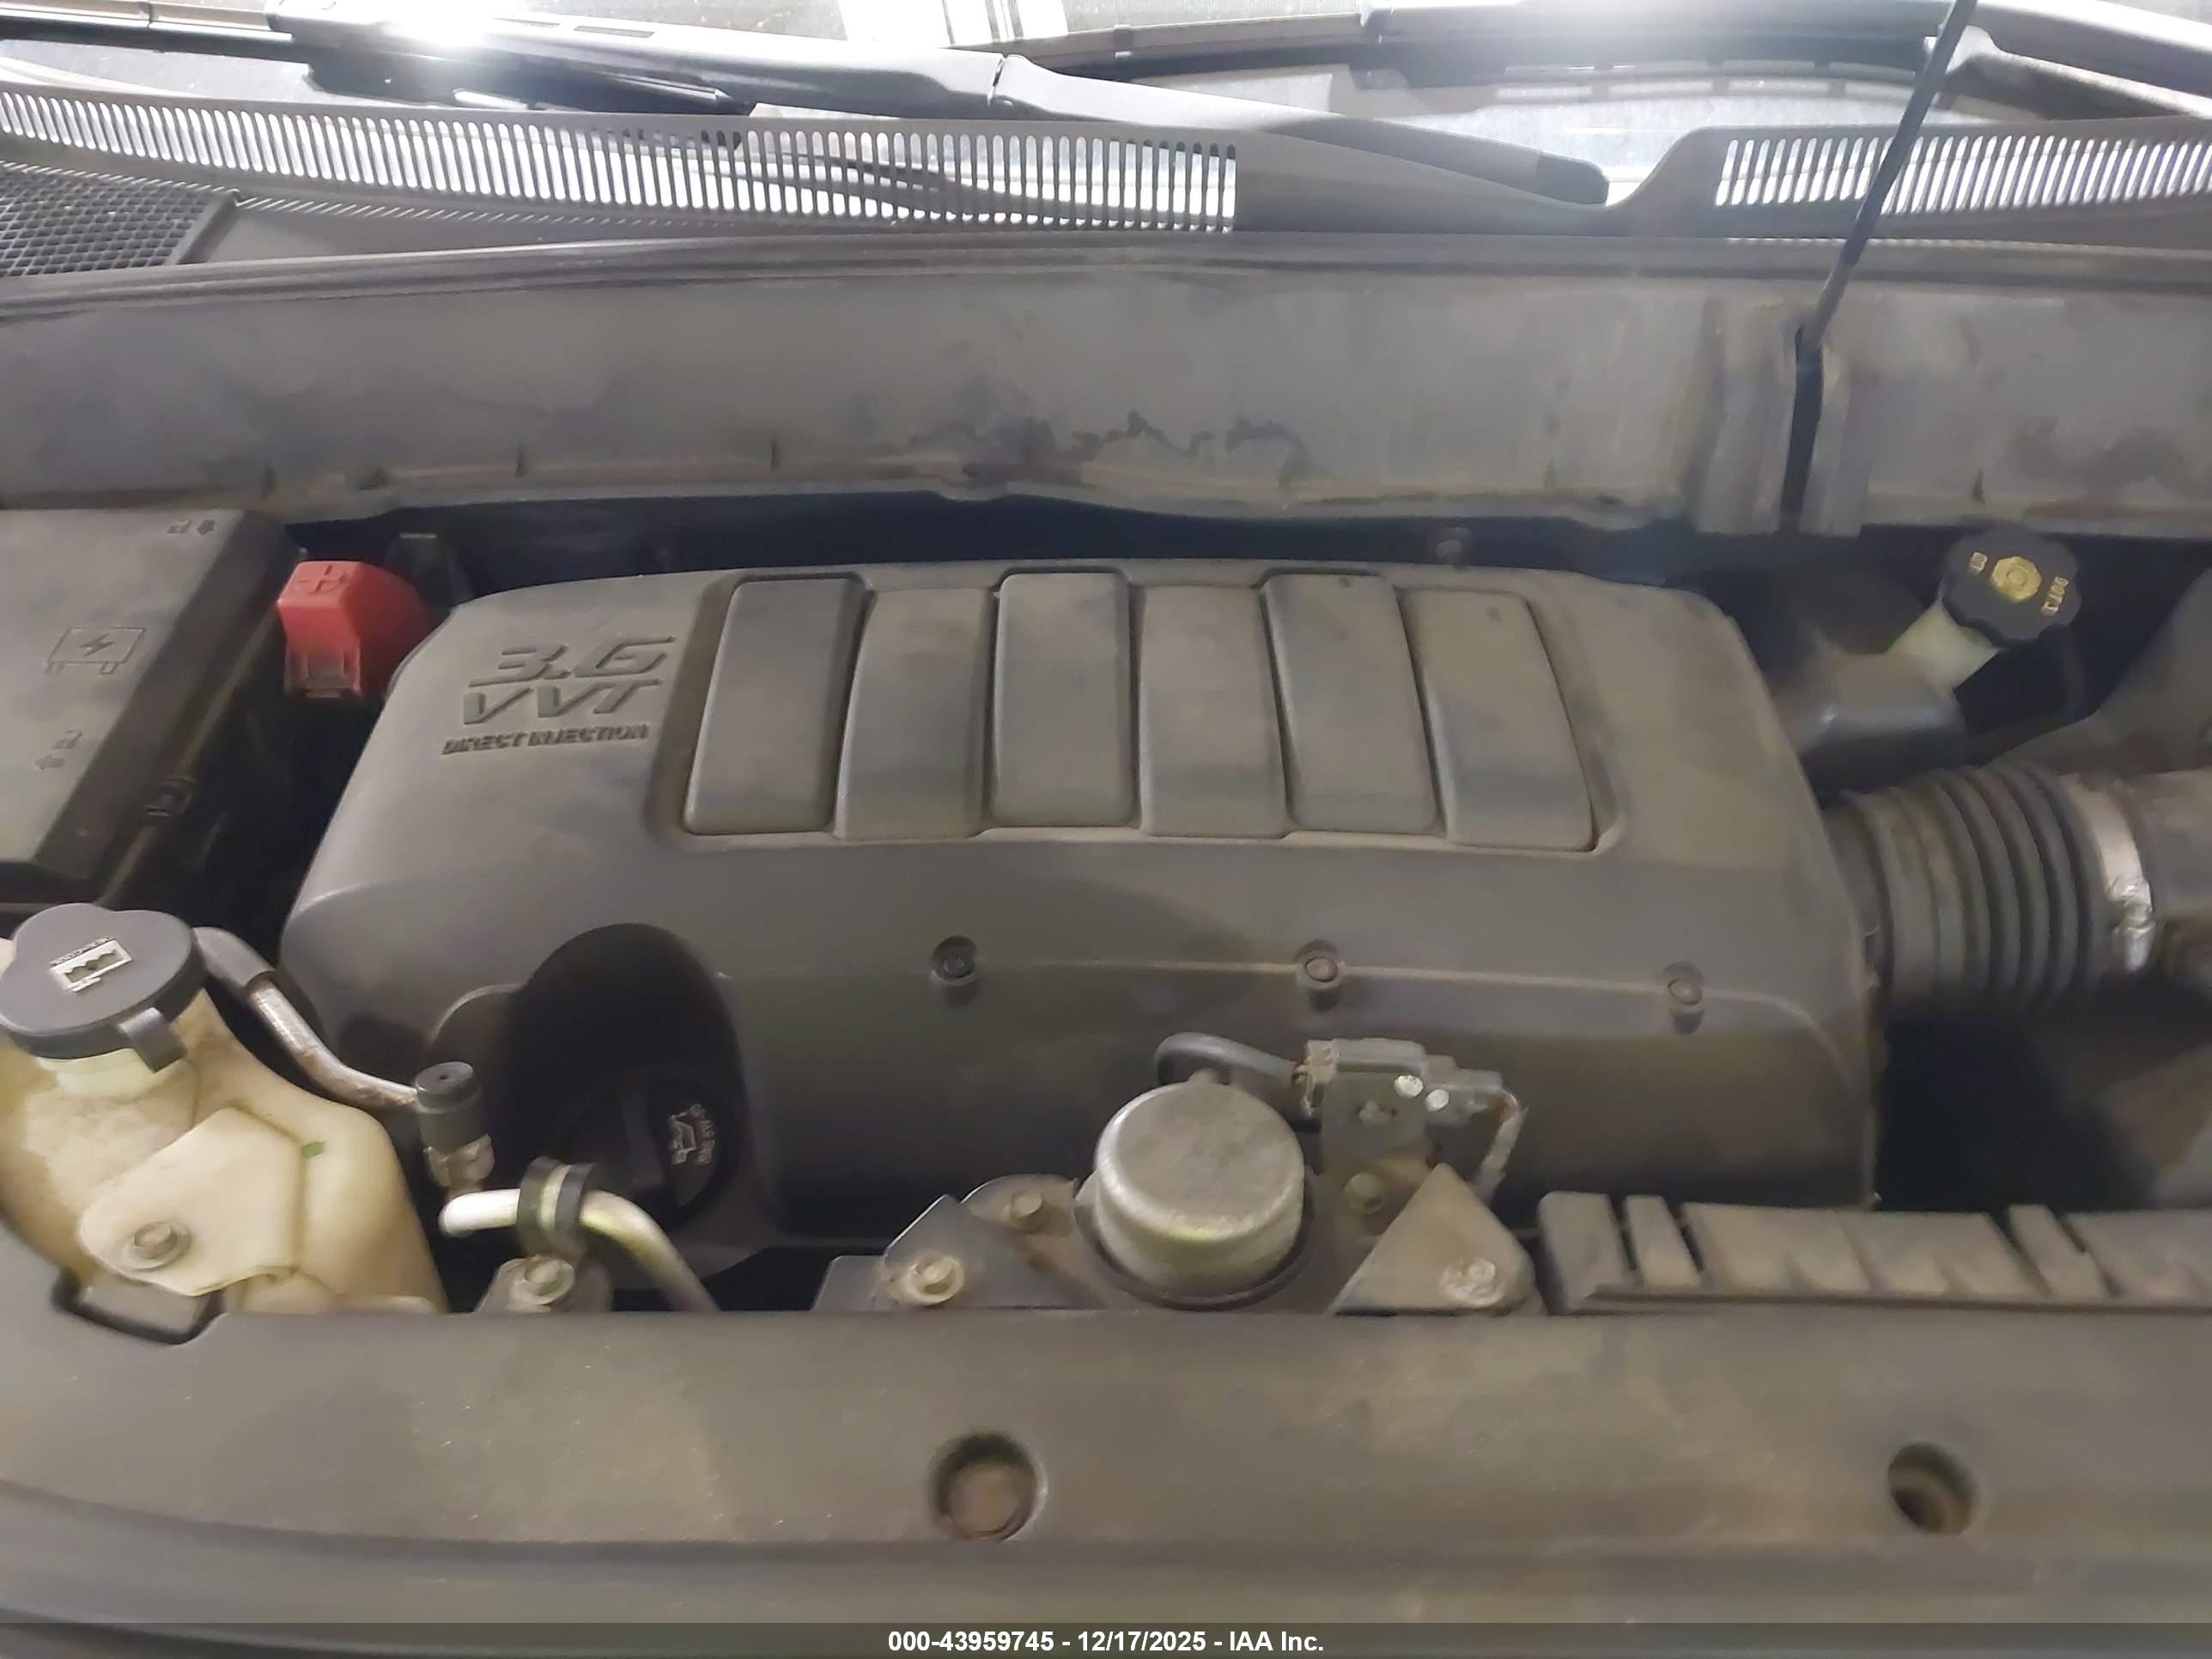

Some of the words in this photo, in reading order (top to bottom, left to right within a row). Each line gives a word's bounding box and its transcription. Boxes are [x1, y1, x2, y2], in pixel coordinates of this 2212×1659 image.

[468, 635, 677, 688] 3.6
[463, 678, 663, 725] VVT
[441, 732, 526, 755] DIRECT
[527, 723, 650, 747] INJECTION
